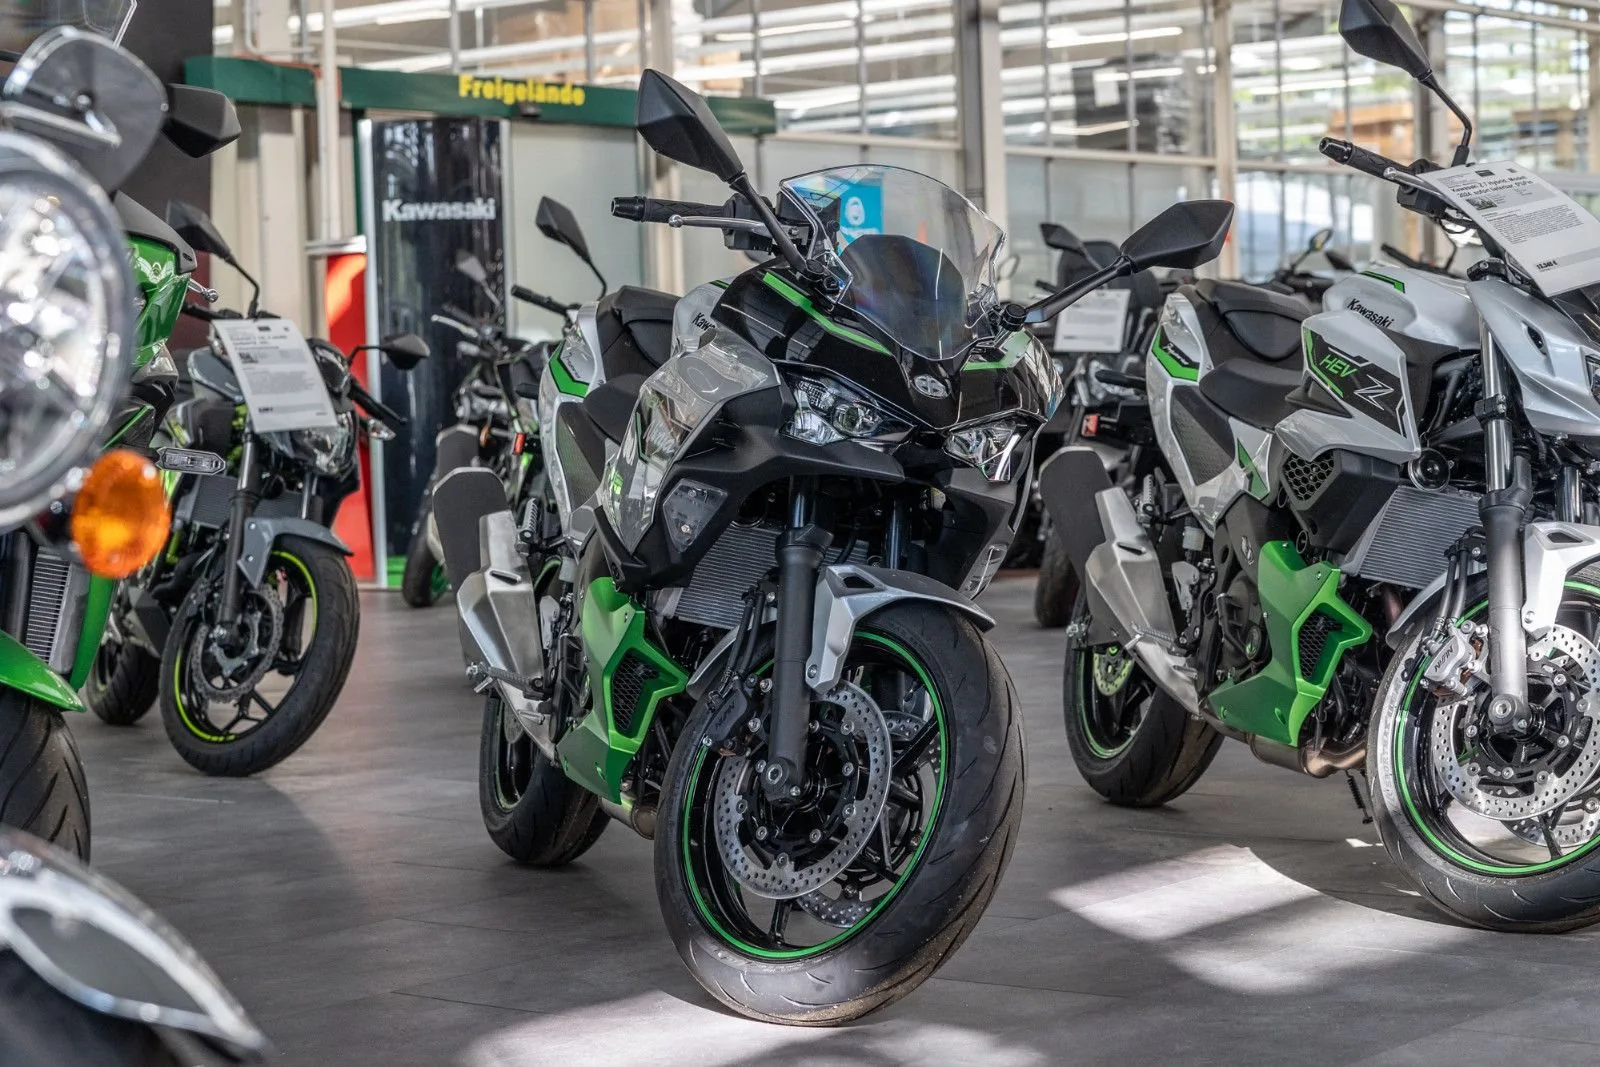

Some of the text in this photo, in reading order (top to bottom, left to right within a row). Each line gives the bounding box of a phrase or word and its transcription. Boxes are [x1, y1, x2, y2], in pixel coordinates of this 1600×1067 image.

[458, 74, 585, 106] Freigelände
[382, 197, 496, 222] Kawasaki
[1347, 298, 1394, 328] Kawasaki
[1320, 354, 1358, 377] HEV
